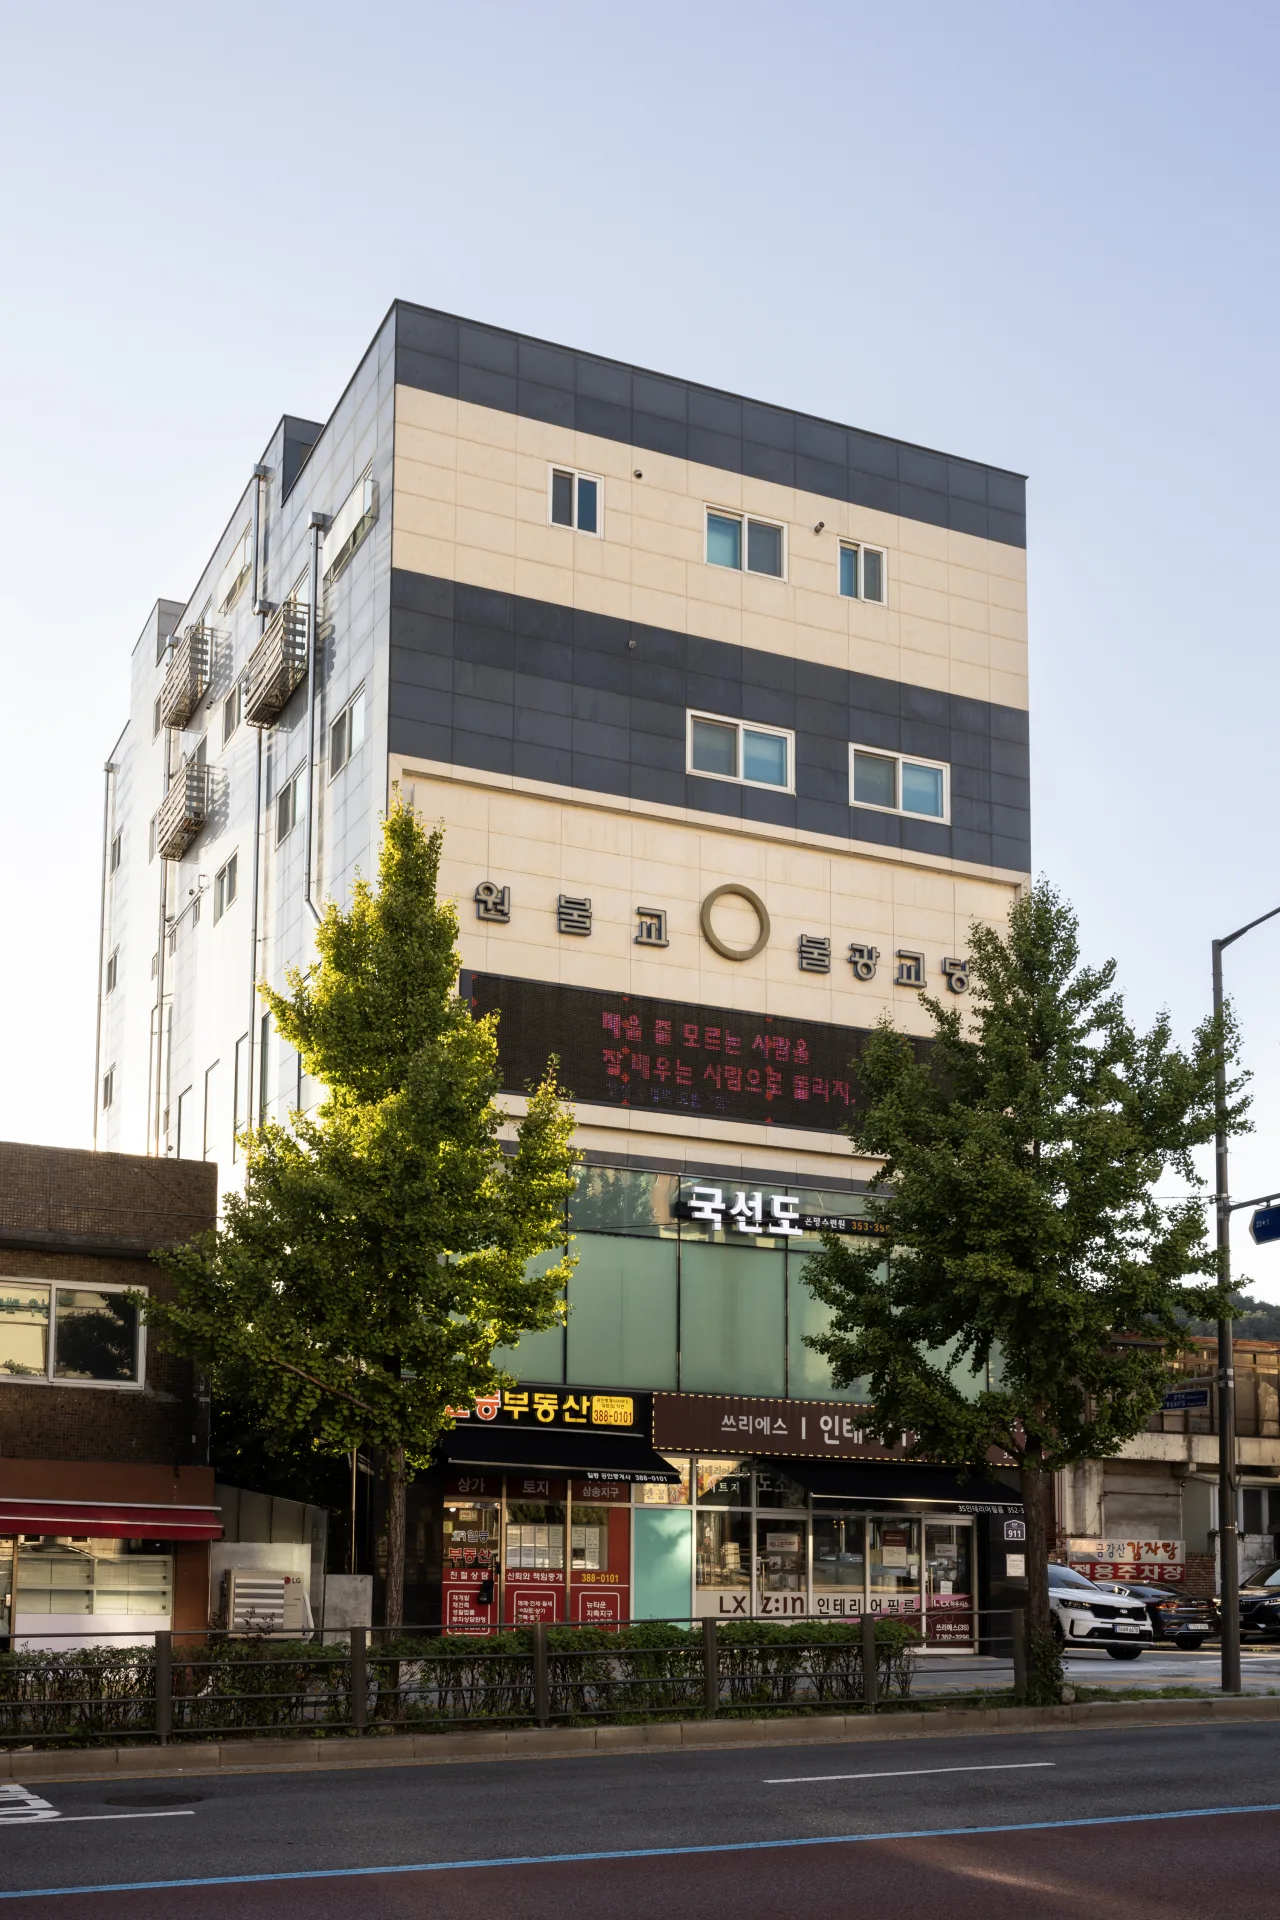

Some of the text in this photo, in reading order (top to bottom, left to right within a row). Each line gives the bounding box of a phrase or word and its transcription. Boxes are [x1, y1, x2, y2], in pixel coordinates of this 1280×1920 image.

[475, 881, 669, 948] 원불교
[683, 1023, 742, 1056] 모르는
[752, 1034, 810, 1065] 사람을
[631, 1053, 692, 1085] 배우는
[704, 1064, 782, 1096] 사람으로
[687, 1186, 803, 1235] 국선도
[804, 1217, 846, 1230] 은평수련원
[594, 1410, 632, 1424] 388-0101
[721, 1415, 788, 1435] 쓰리에스
[458, 1477, 485, 1492] 상가
[635, 1474, 668, 1483] 388-0101
[522, 1480, 549, 1495] 토지
[582, 1486, 620, 1498] 삼송지구
[1008, 1529, 1021, 1538] 911
[448, 1547, 492, 1563] 부동산
[1096, 1543, 1126, 1558] 금강산
[507, 1572, 563, 1582] 신뢰와 책임중개
[581, 1573, 620, 1583] 388-0101
[1071, 1564, 1184, 1581] 전용주차장
[587, 1600, 607, 1609] 뉴타운
[719, 1595, 748, 1614] LX
[936, 1624, 969, 1632] 쓰리에스(3S)
